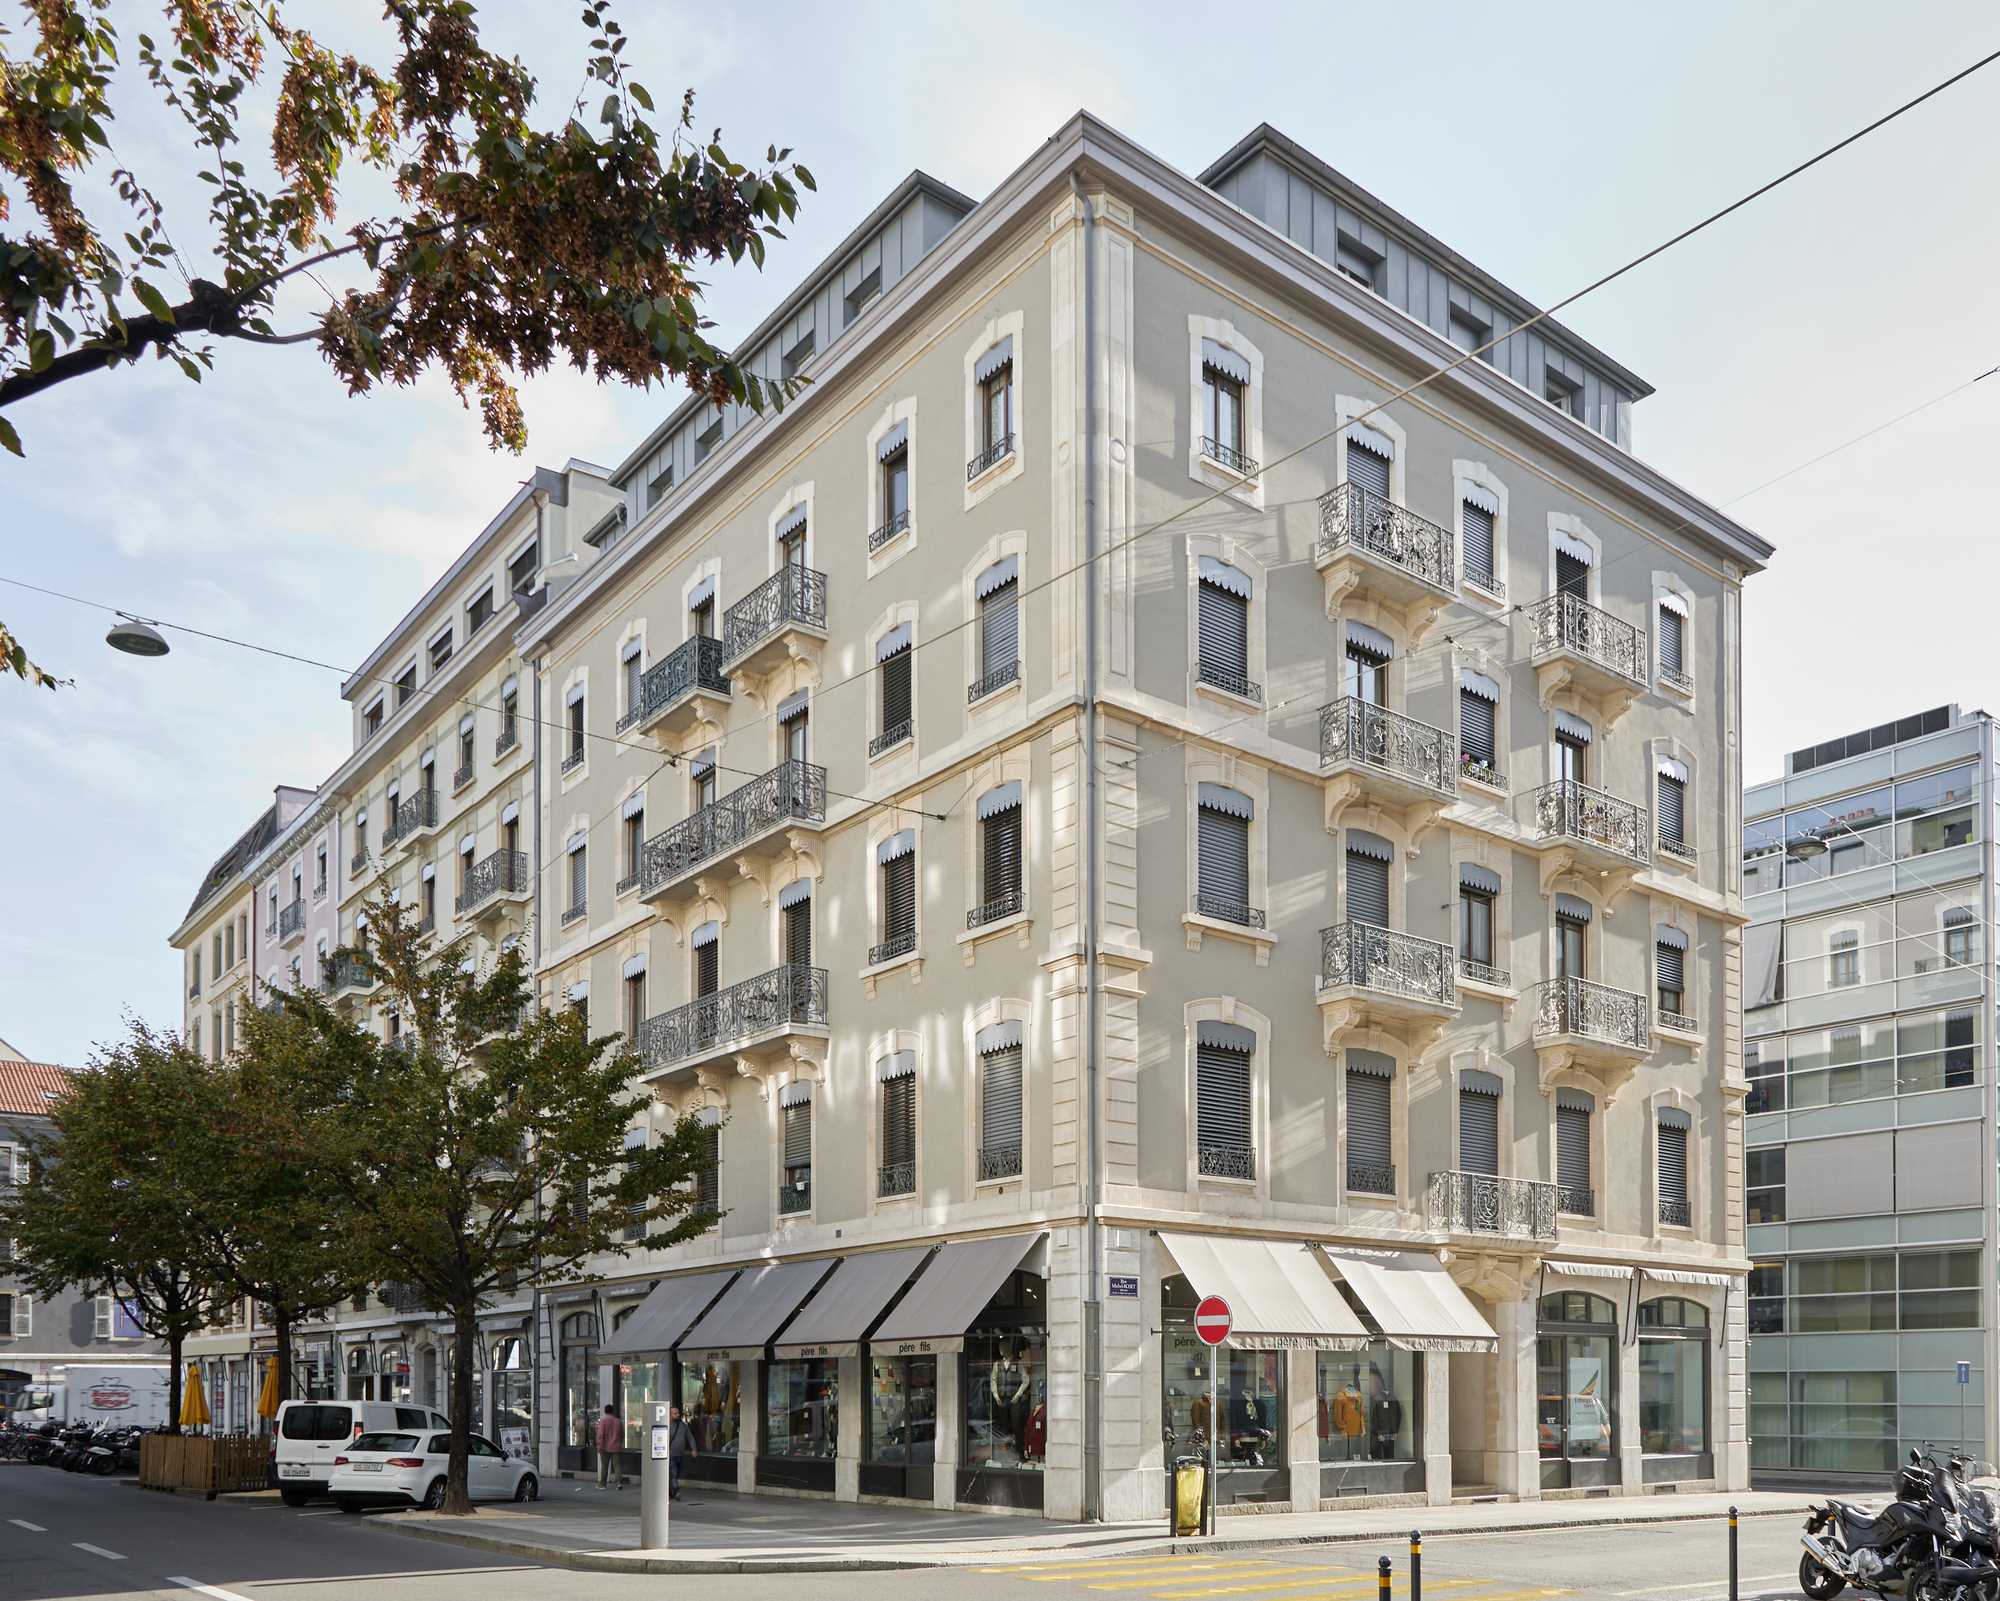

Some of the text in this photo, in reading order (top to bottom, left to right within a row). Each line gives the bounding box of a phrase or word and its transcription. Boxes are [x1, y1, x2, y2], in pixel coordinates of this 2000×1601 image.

[800, 1345, 828, 1357] père fils
[899, 1341, 931, 1354] père fils
[656, 1406, 666, 1421] P
